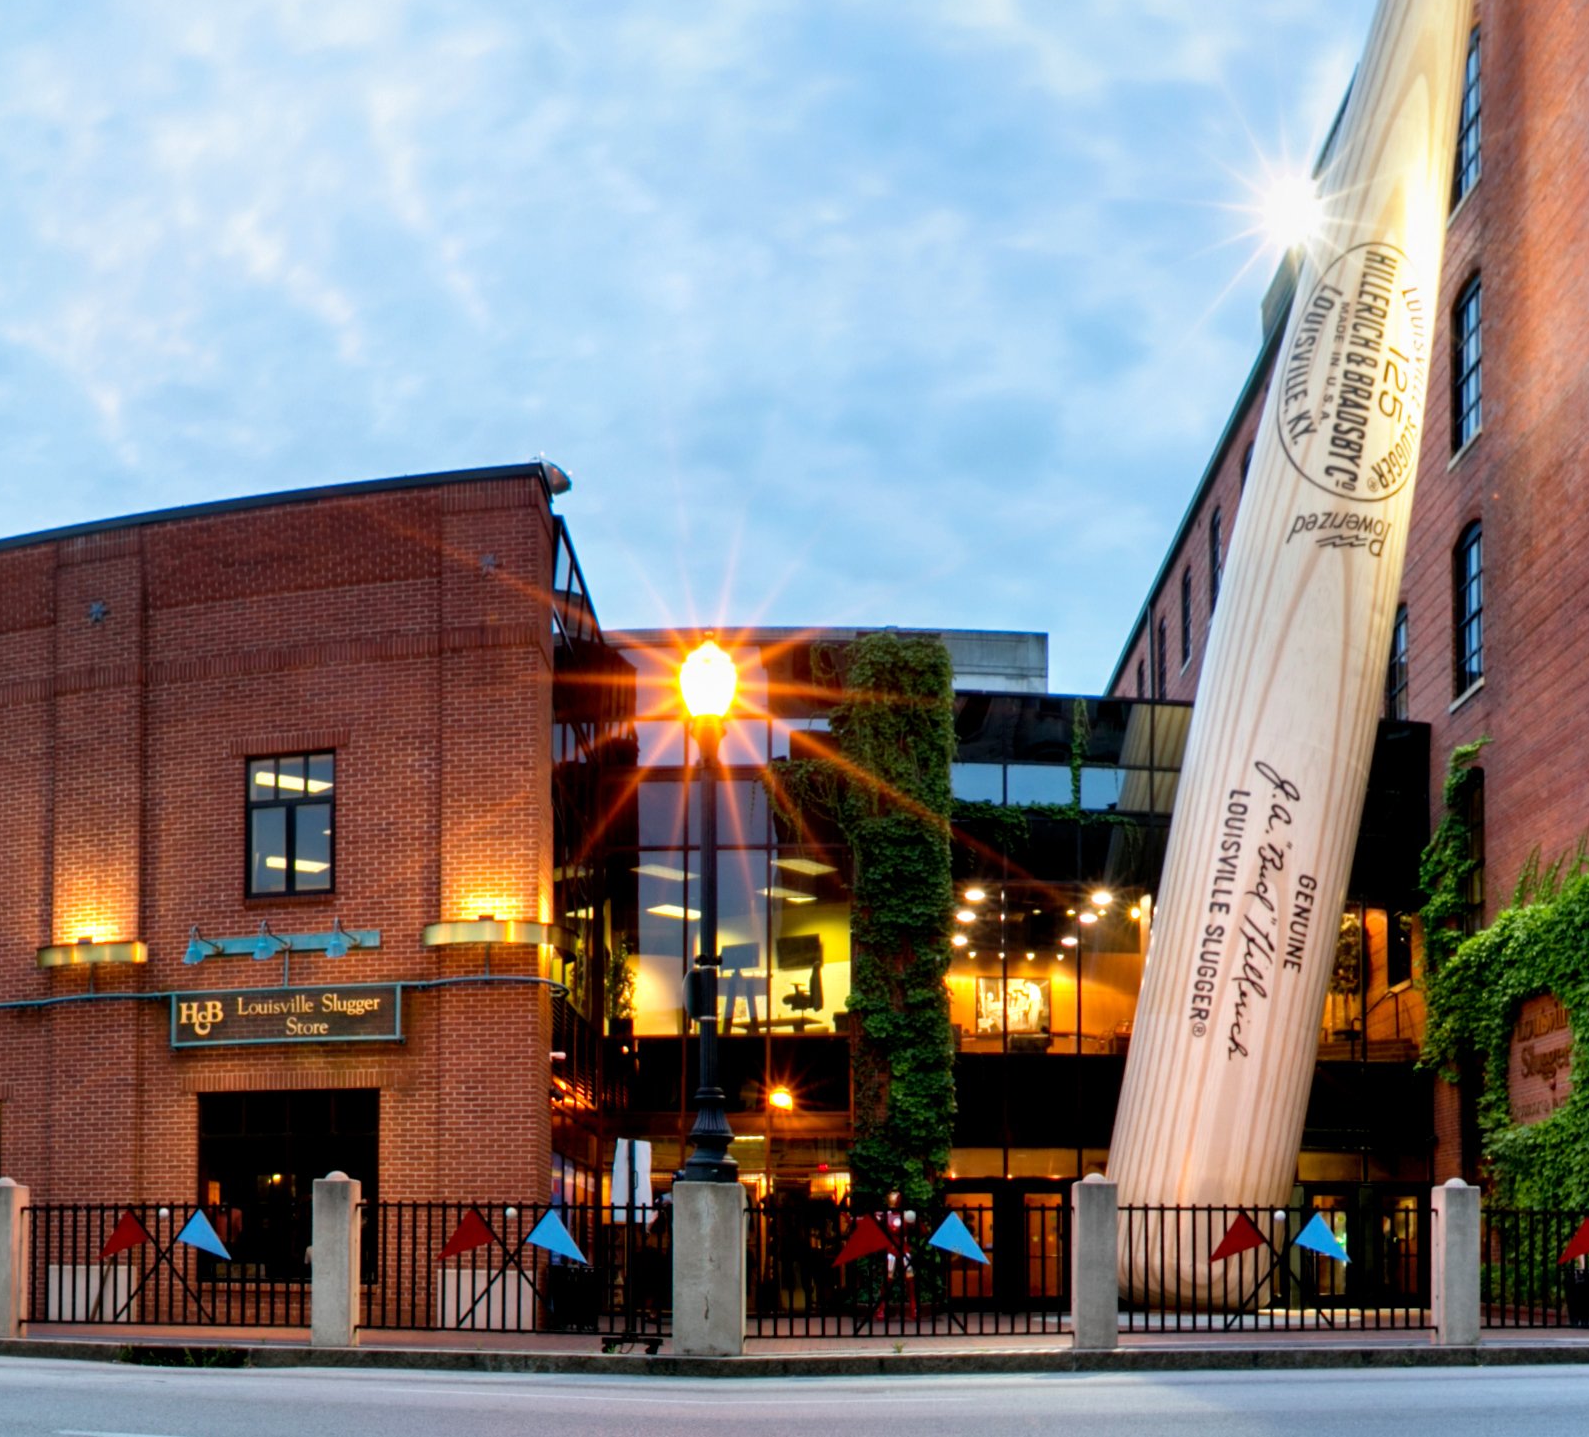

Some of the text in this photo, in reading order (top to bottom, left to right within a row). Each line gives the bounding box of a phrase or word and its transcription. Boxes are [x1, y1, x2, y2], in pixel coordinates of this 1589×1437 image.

[1334, 301, 1350, 343] MADE
[1349, 249, 1398, 353] HILLERICH
[1330, 351, 1342, 367] IN
[1346, 350, 1379, 370] &
[1378, 346, 1410, 423] 125
[1328, 369, 1376, 469] BRADSBY
[1286, 511, 1392, 557] Powerized
[1209, 789, 1251, 915] LOUISVILLE
[1283, 873, 1318, 974] GENUINE
[237, 993, 380, 1015] Louisville Slugger
[1228, 914, 1275, 1061] Hillerich
[286, 1017, 329, 1035] Store
[1520, 1044, 1571, 1081] Slugger
